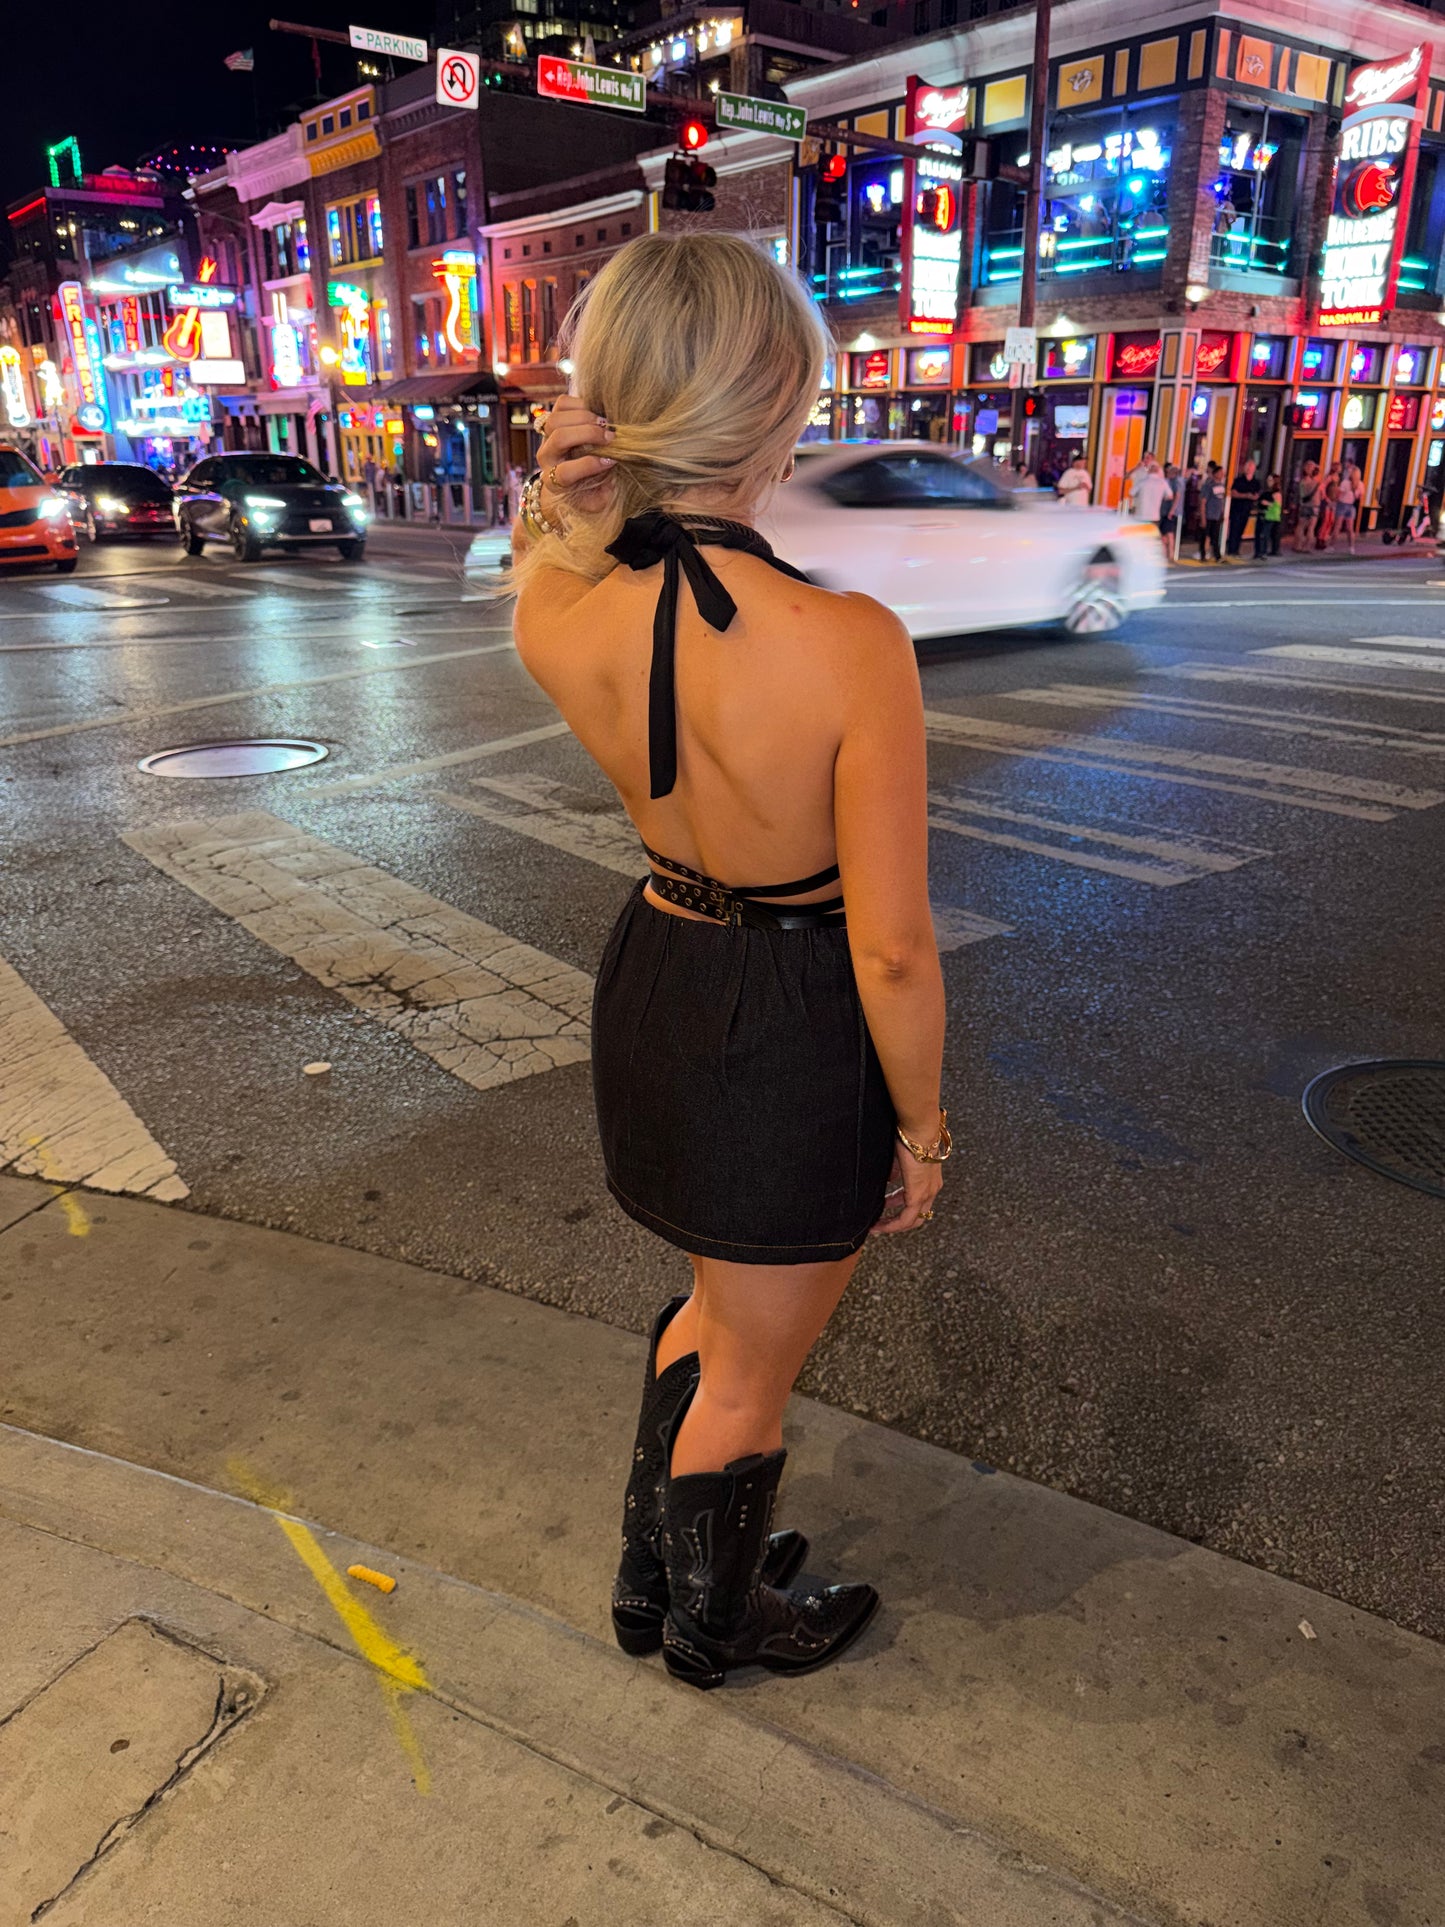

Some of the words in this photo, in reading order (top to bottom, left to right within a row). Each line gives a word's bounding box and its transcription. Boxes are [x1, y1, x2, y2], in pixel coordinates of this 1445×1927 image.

[367, 33, 423, 58] PARKING
[575, 69, 595, 92] John
[595, 73, 619, 97] Lewis
[621, 83, 632, 102] Way
[633, 82, 641, 102] N
[736, 101, 754, 121] John
[754, 104, 774, 127] Lewis
[785, 112, 792, 132] S
[1340, 119, 1408, 161] RIBS
[1319, 311, 1381, 326] NASHVILLE
[63, 287, 95, 403] FRIENDS
